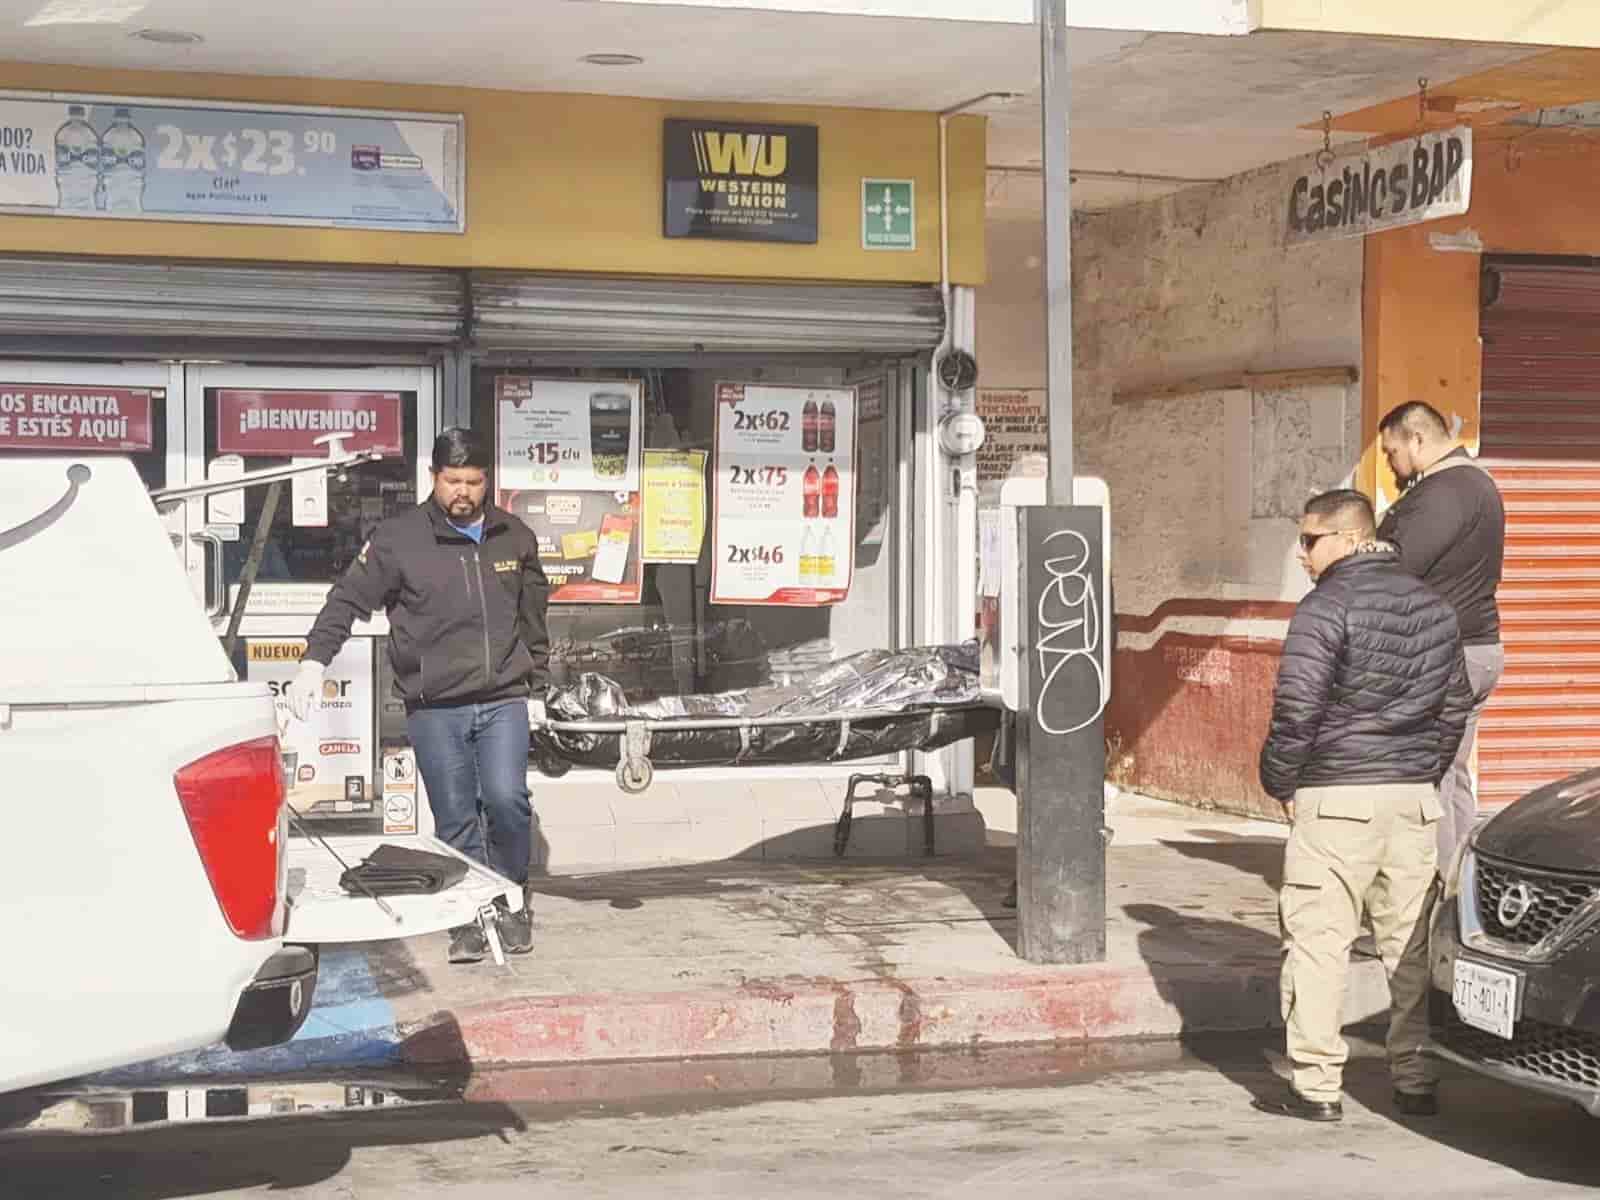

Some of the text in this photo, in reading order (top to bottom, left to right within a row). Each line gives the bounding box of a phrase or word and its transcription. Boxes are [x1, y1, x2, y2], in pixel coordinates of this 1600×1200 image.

[0, 128, 33, 149] DO?
[11, 152, 46, 174] VIDA
[693, 131, 787, 176] WU
[701, 180, 786, 194] WESTERN
[728, 194, 786, 208] UNION
[32, 395, 120, 415] ENCANTA
[17, 415, 73, 437] ESTÉS
[79, 416, 128, 442] AQUÍ
[239, 409, 378, 433] ¡BIENVENIDO!
[528, 442, 559, 464] $15
